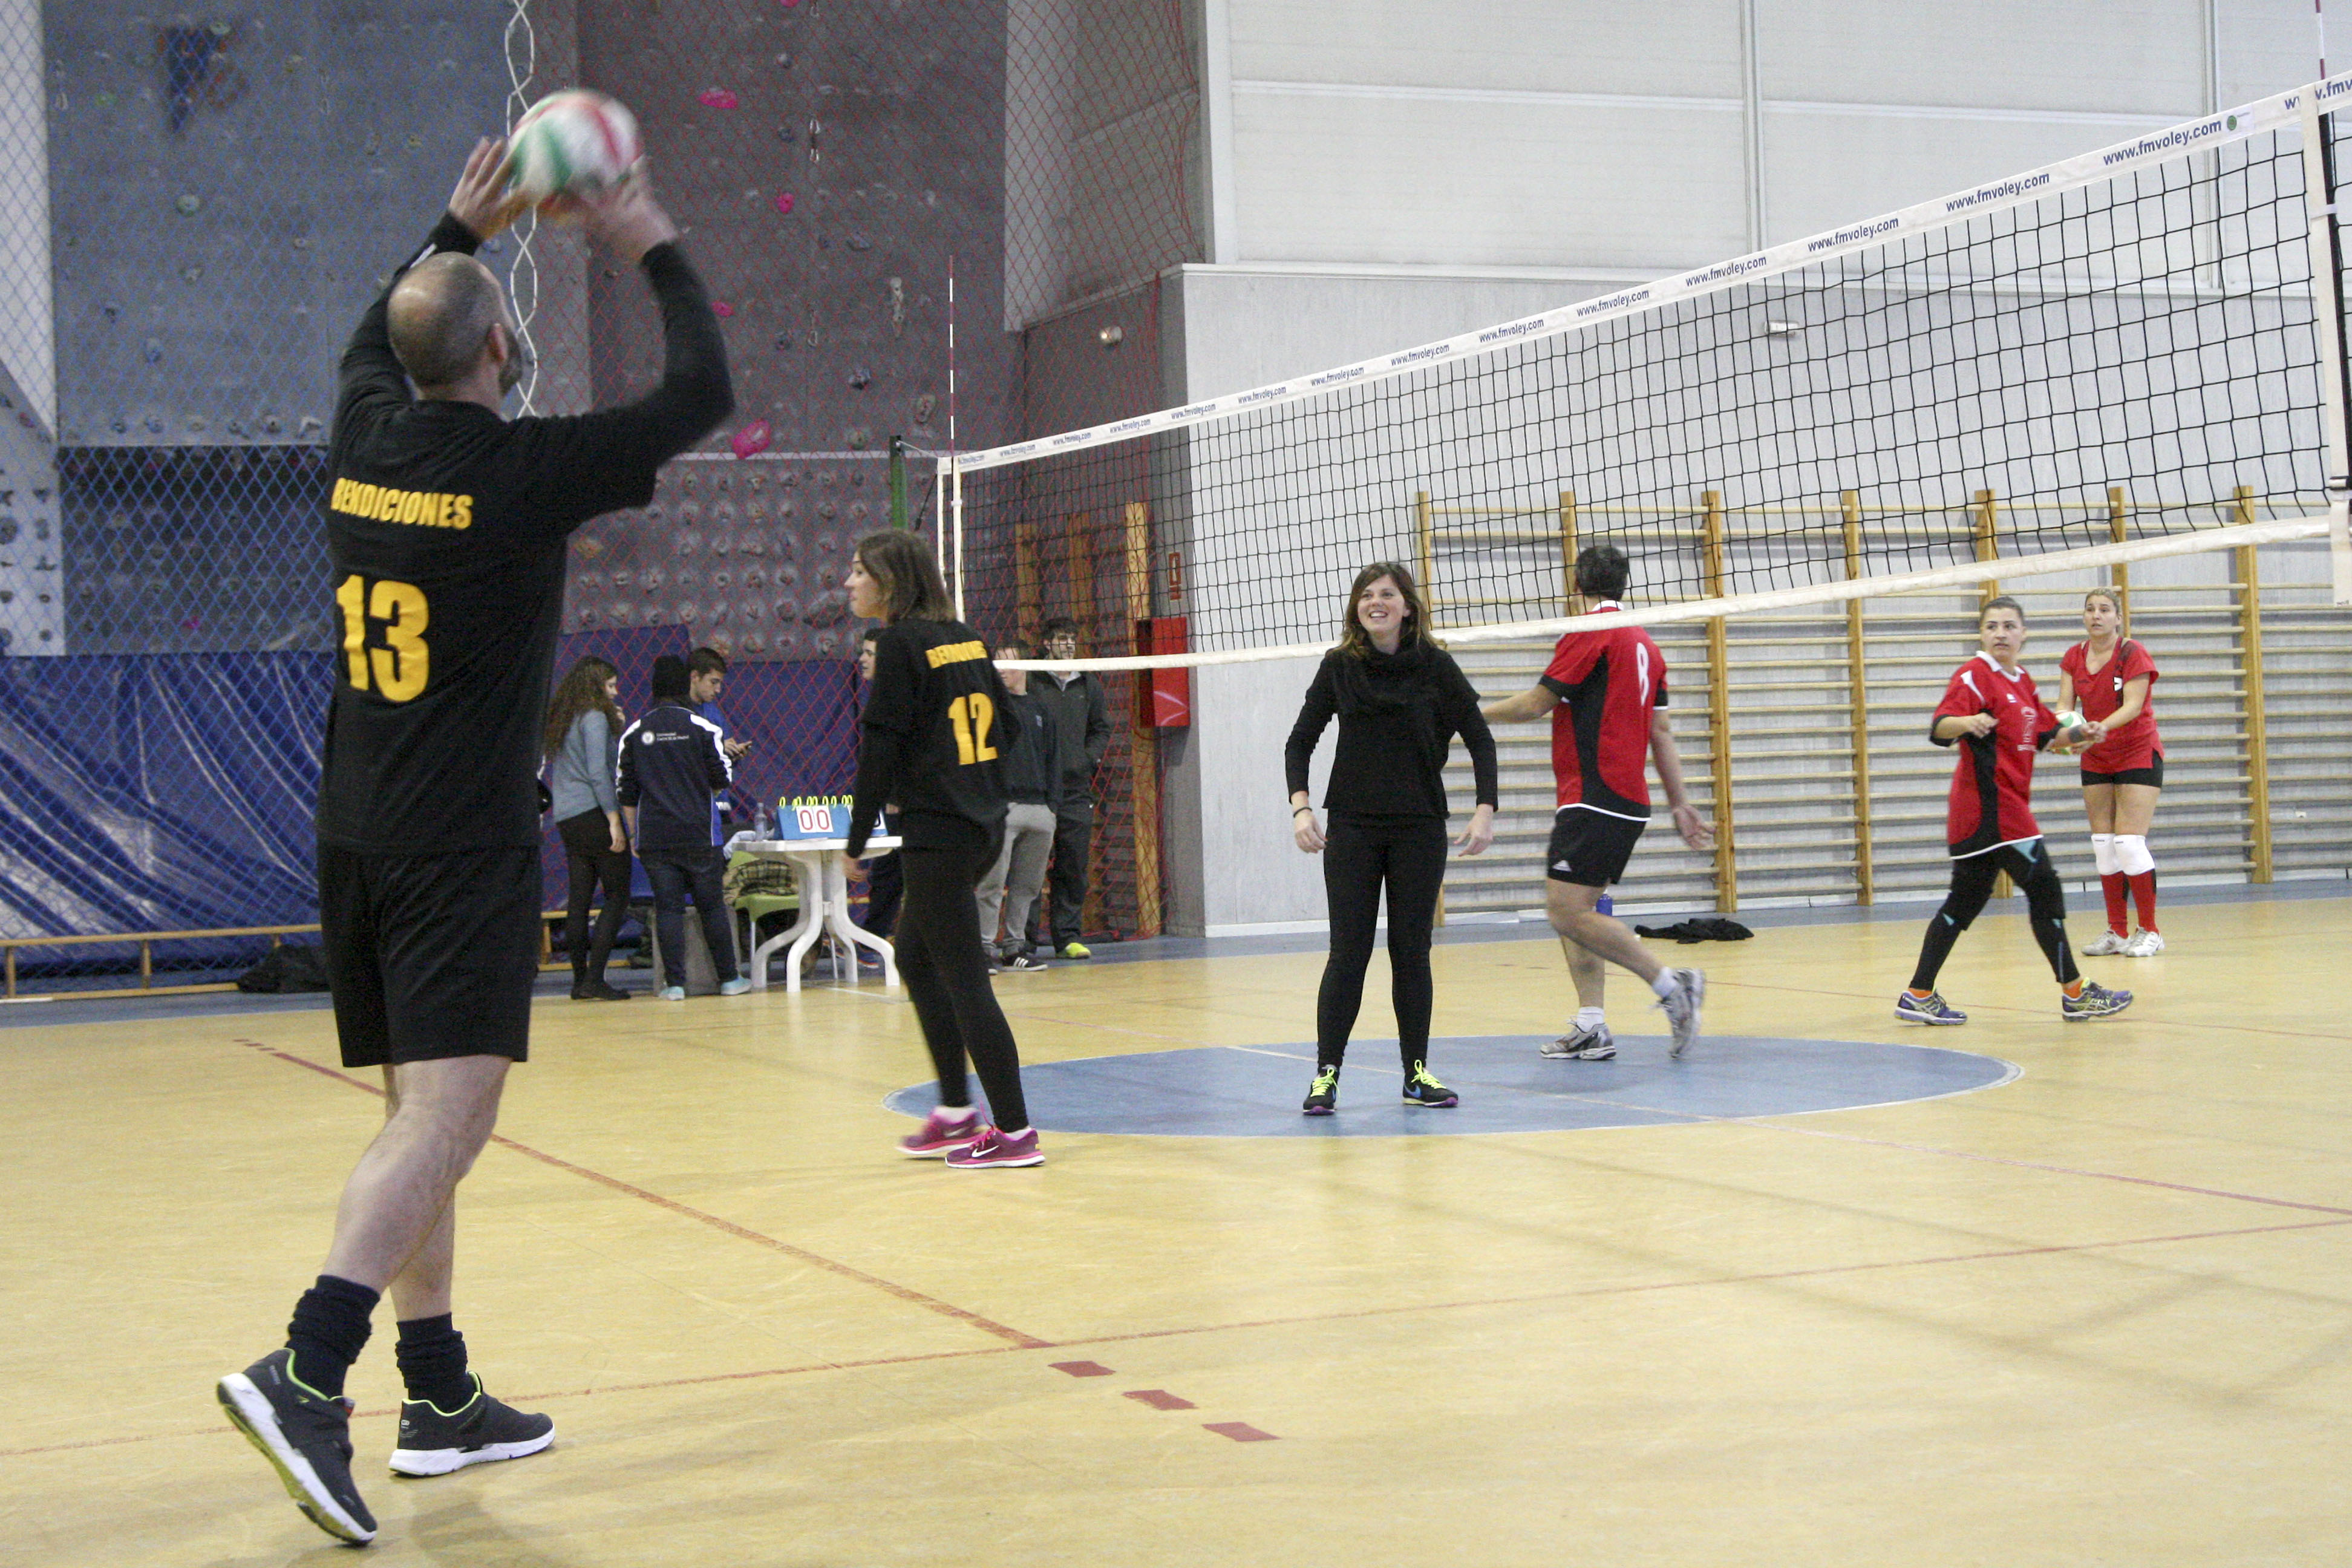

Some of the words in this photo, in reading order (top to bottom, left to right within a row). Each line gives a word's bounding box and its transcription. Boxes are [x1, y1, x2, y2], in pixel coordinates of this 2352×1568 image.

[2103, 120, 2222, 166] www.fmvoley.com
[1946, 173, 2050, 212] www.fmvoley.com
[1808, 217, 1899, 252] www.fmvoley.com
[1685, 255, 1767, 287] www.fmvoley.com
[1576, 289, 1650, 317] www.fmvoley.com
[1479, 318, 1544, 344] www.fmvoley.com
[1391, 343, 1450, 366] www.fmvoley.com
[1310, 366, 1364, 387] www.fmvoley.com
[336, 574, 429, 702] 13
[948, 692, 998, 765] 12
